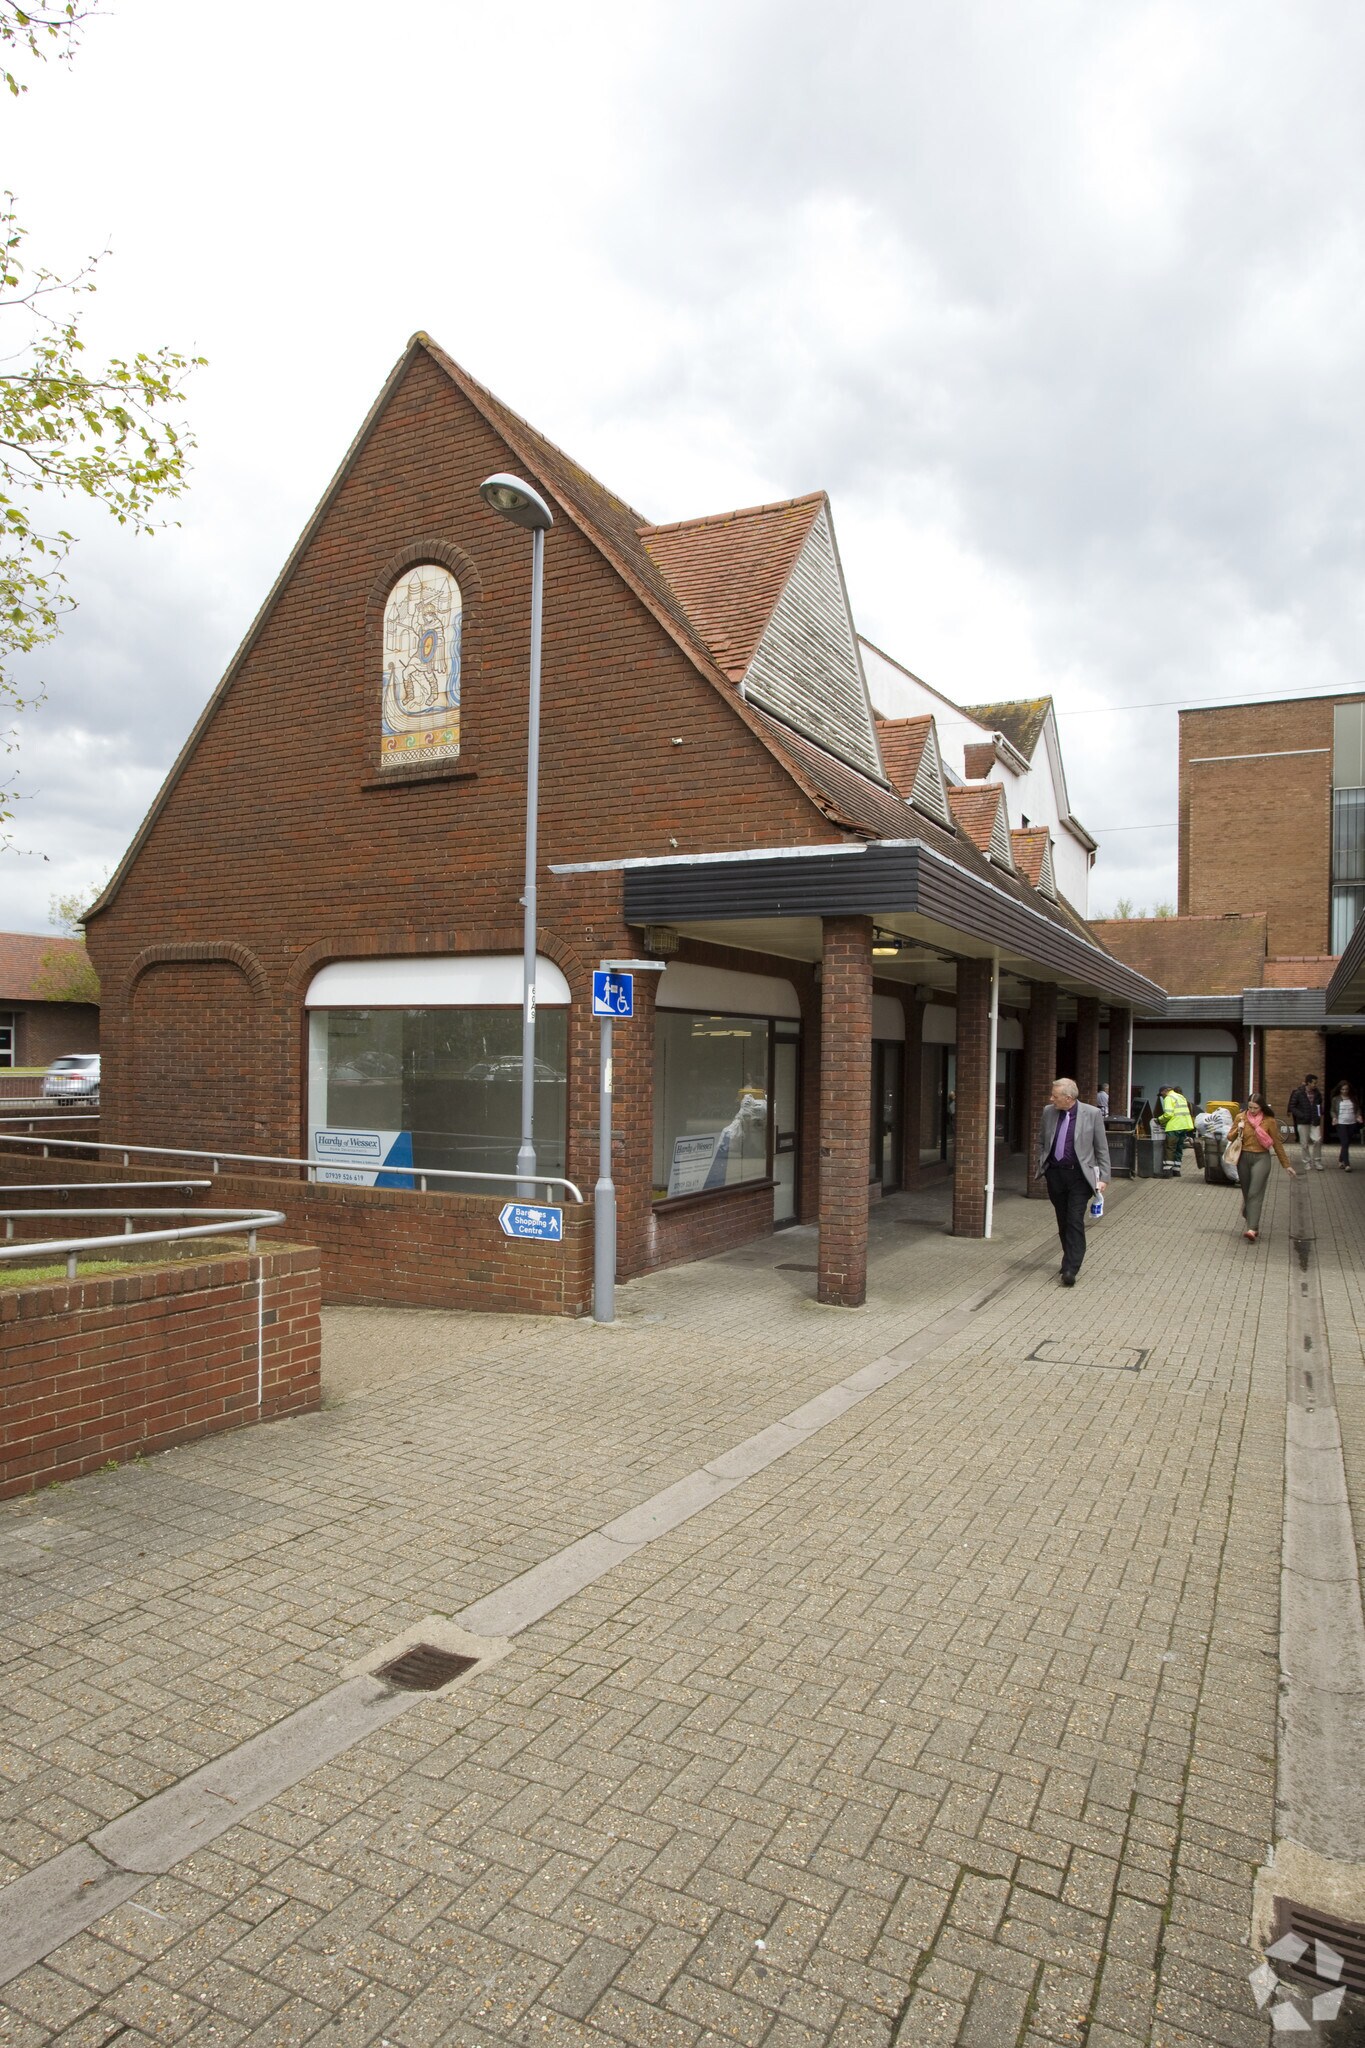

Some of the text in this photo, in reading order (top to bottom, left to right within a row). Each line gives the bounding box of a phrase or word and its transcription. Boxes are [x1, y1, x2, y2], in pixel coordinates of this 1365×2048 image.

[318, 1136, 342, 1147] Hardy
[349, 1138, 377, 1147] Wessex
[515, 1216, 547, 1227] Shopping
[519, 1226, 543, 1234] Centre
